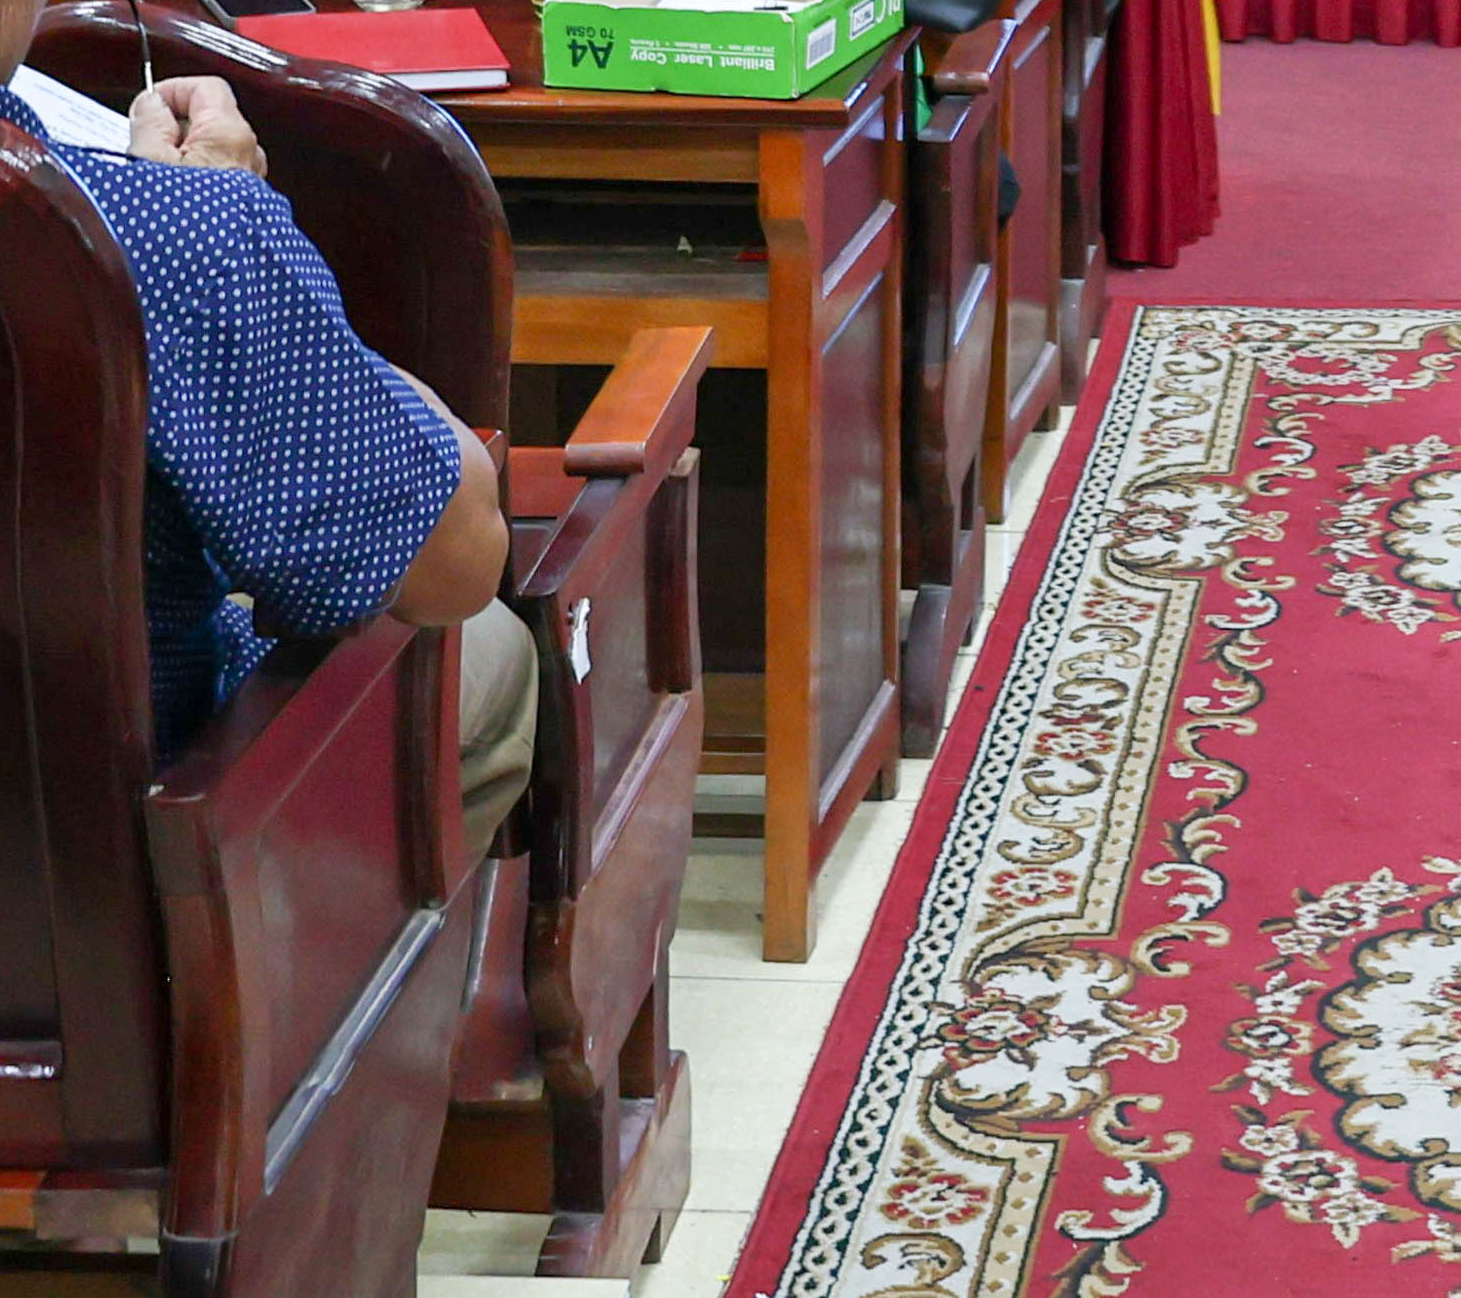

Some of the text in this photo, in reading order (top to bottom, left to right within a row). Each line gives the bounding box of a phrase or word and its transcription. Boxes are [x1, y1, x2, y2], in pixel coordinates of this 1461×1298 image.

[566, 25, 615, 40] 70 GSM
[567, 38, 615, 70] A4
[630, 49, 776, 71] Brilliant Laser Copy
